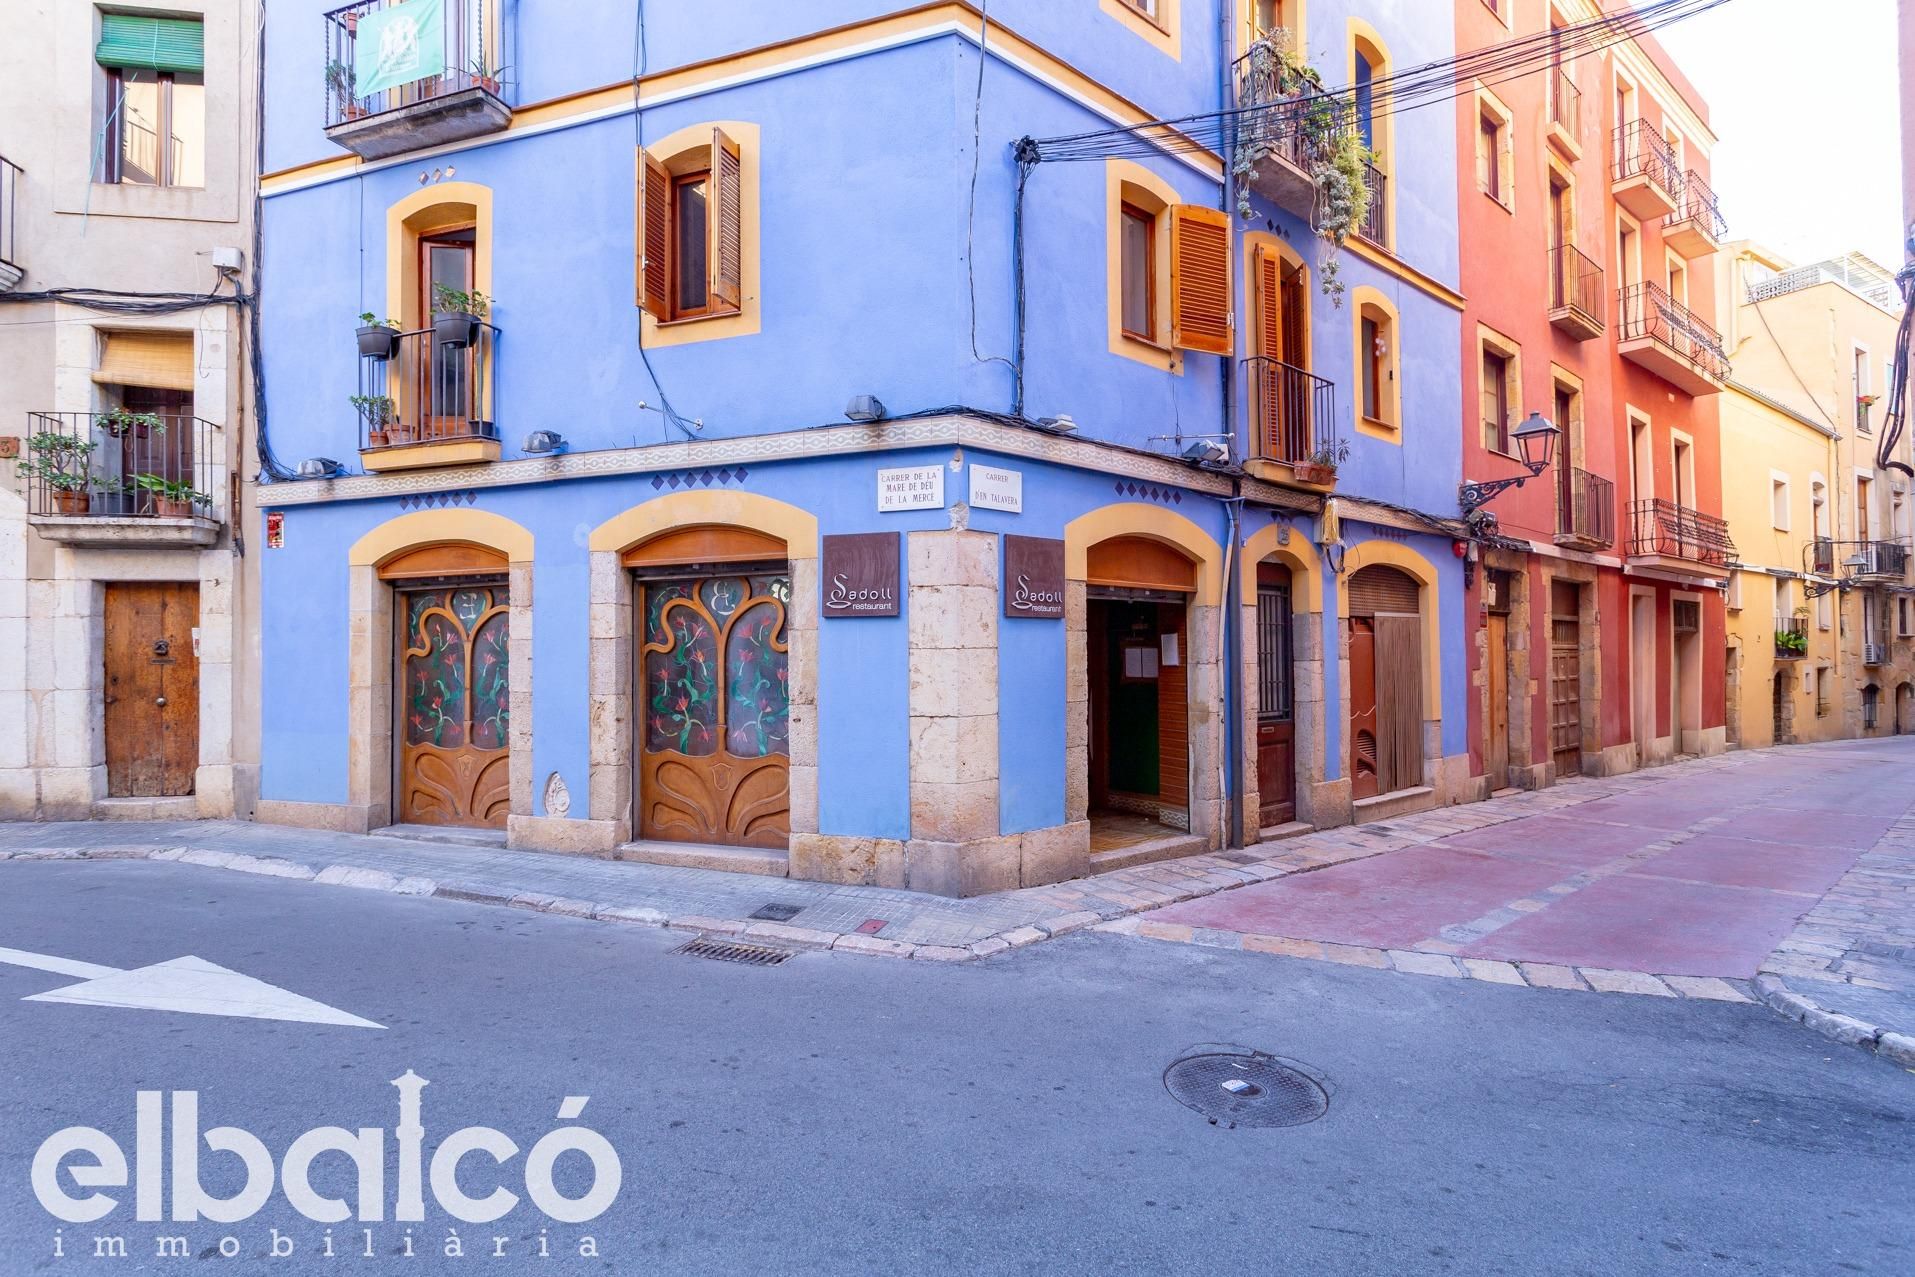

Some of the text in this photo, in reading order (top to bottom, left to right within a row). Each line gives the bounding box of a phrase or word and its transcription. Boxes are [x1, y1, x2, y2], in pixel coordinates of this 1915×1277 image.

[881, 474, 910, 482] CARRER
[985, 473, 1009, 483] CARRER
[887, 483, 906, 492] MARE
[909, 482, 918, 490] DE
[885, 496, 893, 505] DE
[898, 495, 908, 504] LA
[975, 490, 1018, 505] D'EN TALAVERA
[829, 573, 892, 600] Sadoll
[1014, 573, 1063, 603] Sadoll
[852, 602, 892, 610] restaurant
